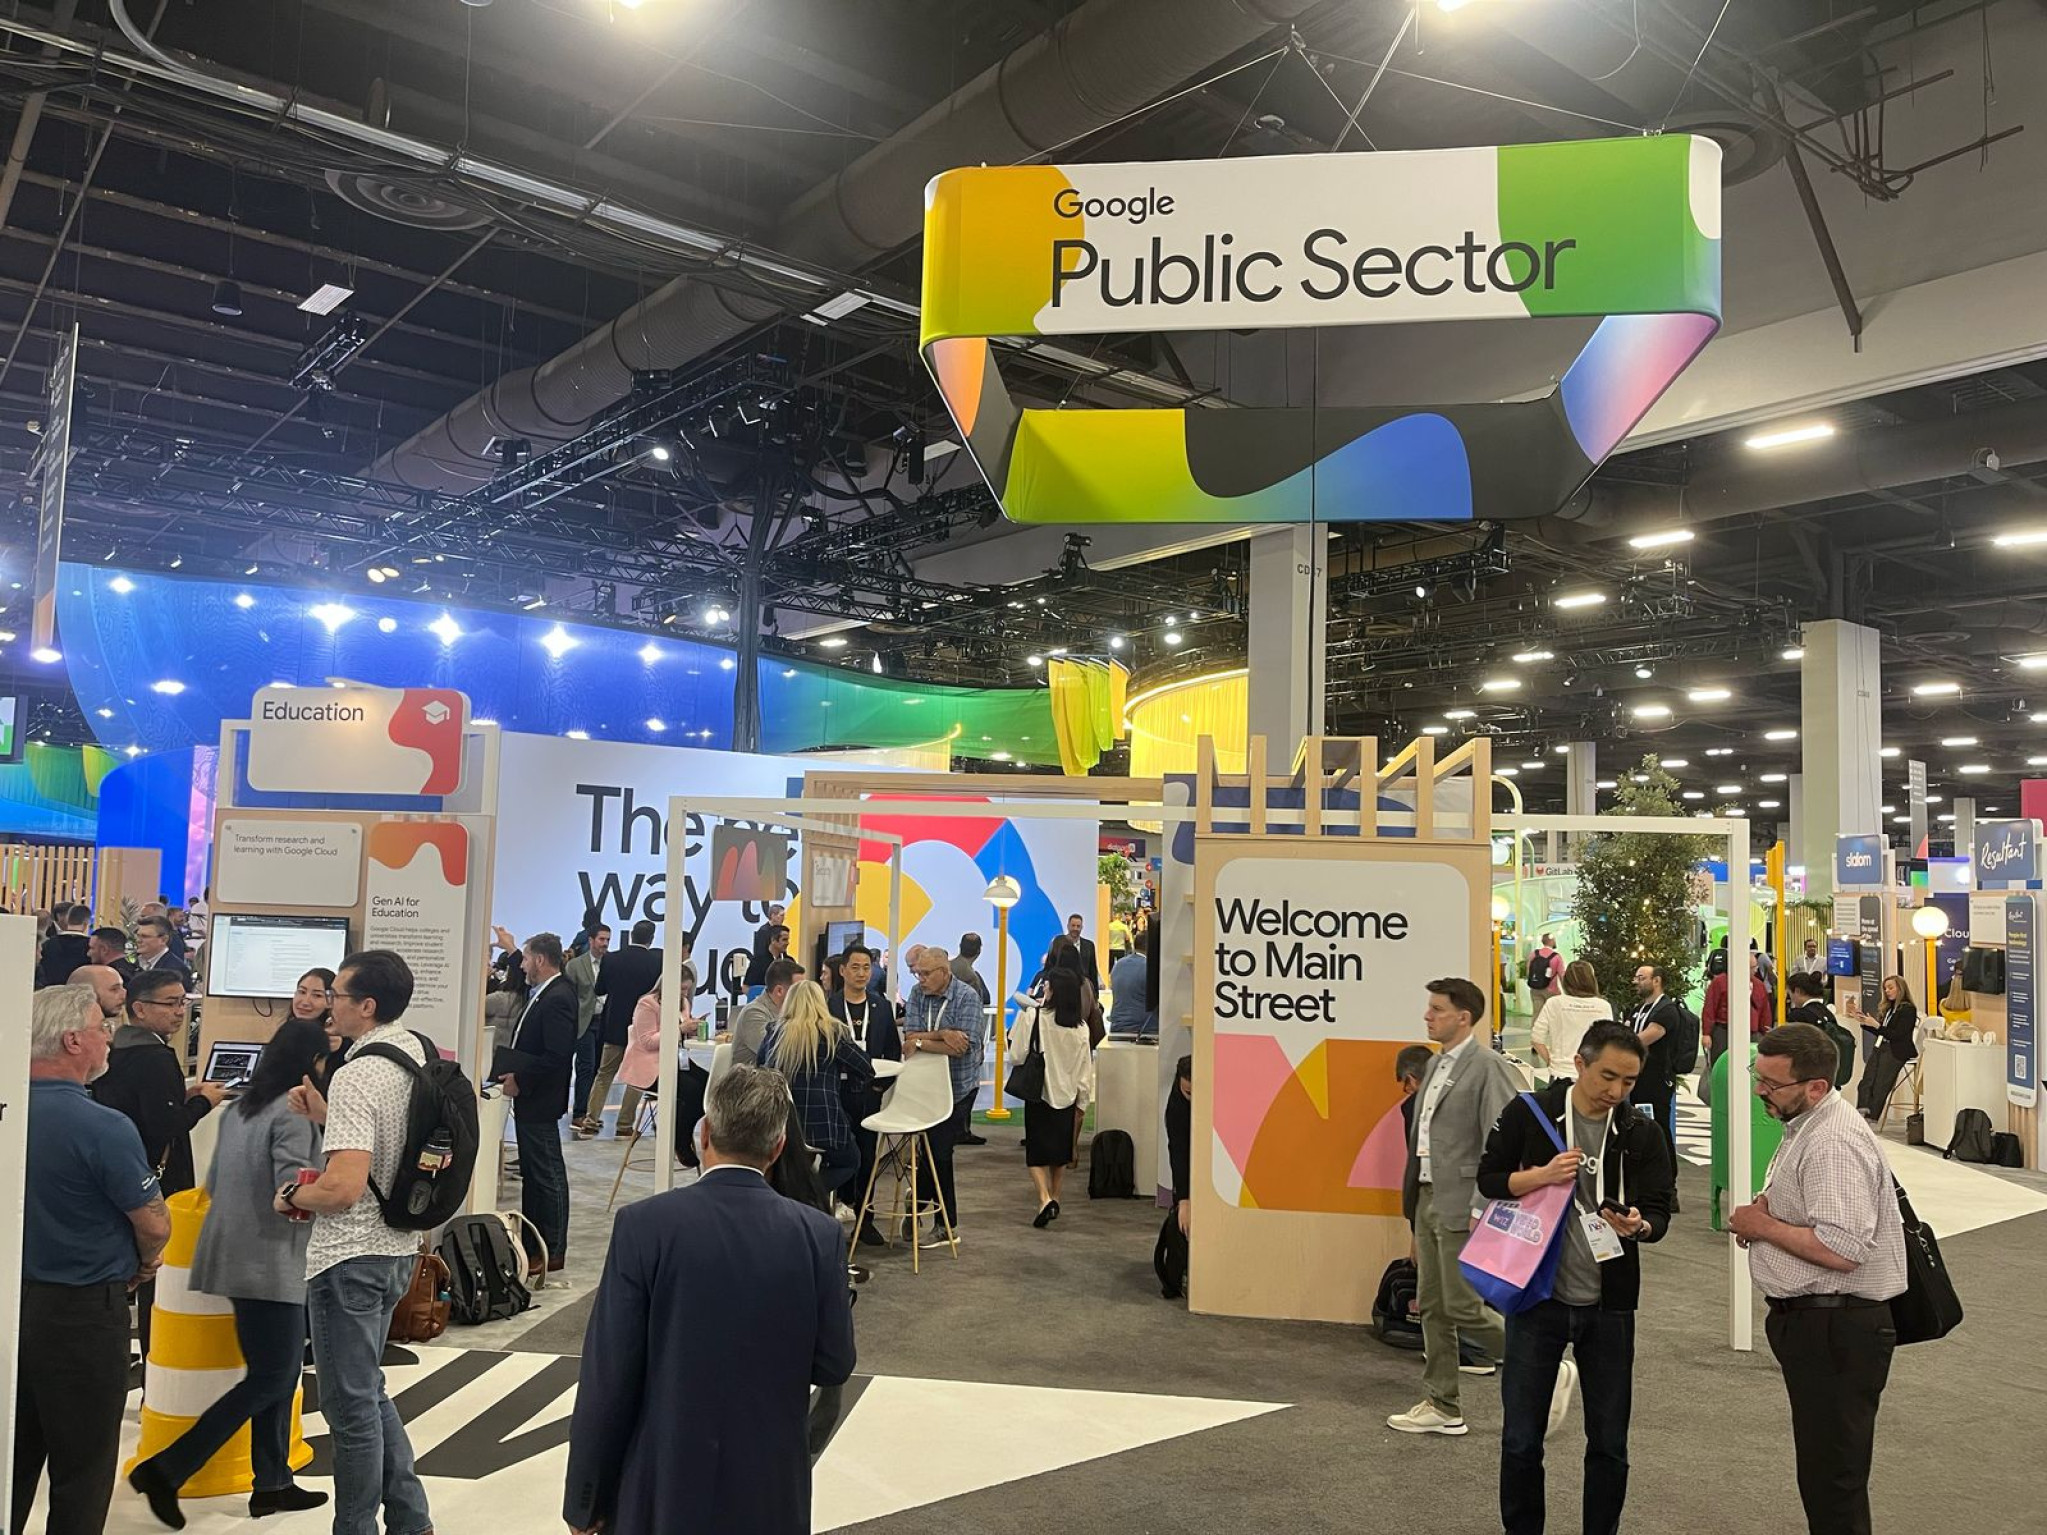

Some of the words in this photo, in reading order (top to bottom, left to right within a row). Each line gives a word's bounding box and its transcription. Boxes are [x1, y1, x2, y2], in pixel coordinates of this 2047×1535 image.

[1053, 187, 1175, 225] Google
[1051, 233, 1283, 308] Public
[1300, 229, 1577, 300] Sector
[1297, 563, 1322, 578] CD7
[263, 701, 364, 721] Education
[236, 833, 273, 843] Transform
[275, 835, 308, 844] research
[310, 836, 325, 845] and
[234, 844, 264, 855] learning
[266, 845, 283, 854] with
[284, 846, 313, 857] Google
[314, 847, 338, 856] Cloud
[1546, 866, 1573, 876] GitLab
[372, 896, 393, 906] Gen
[394, 897, 404, 906] AI
[406, 896, 420, 907] for
[371, 907, 419, 918] Education
[1215, 898, 1408, 940] Welcome
[1944, 928, 1970, 939] Clou
[1215, 943, 1256, 977] to
[1266, 941, 1362, 981] Main
[1214, 981, 1336, 1023] Street
